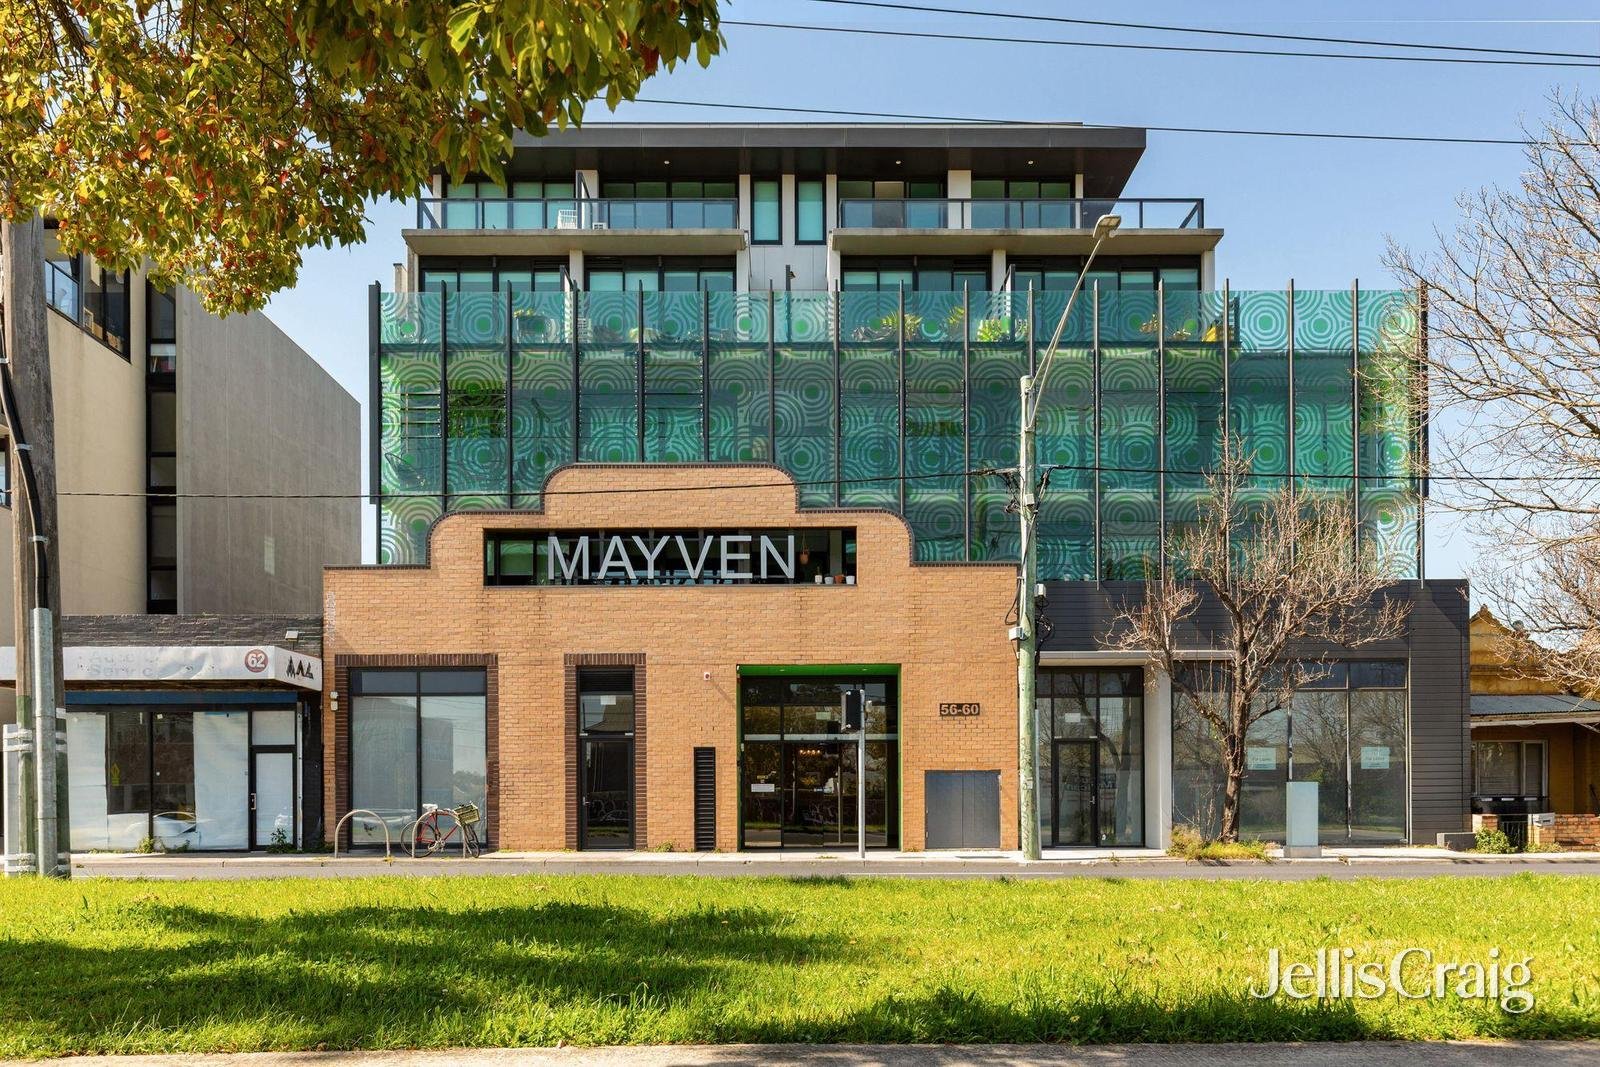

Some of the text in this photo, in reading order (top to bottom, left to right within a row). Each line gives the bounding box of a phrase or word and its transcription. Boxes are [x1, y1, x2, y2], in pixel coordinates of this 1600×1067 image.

[547, 535, 796, 580] MAYVEN
[246, 652, 266, 670] 62
[940, 704, 979, 715] 56-60
